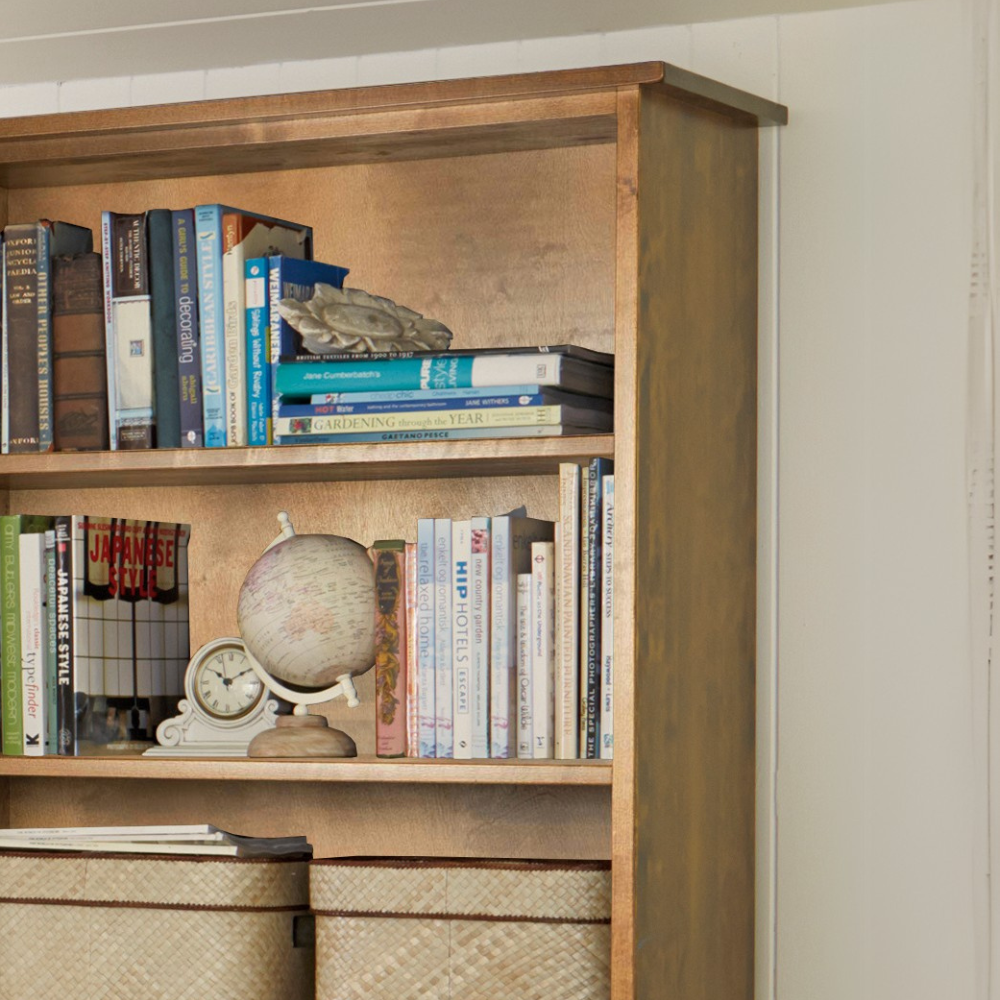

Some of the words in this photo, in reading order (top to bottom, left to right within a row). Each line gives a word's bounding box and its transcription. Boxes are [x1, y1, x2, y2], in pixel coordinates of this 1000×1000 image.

[178, 228, 187, 253] GIRL'S
[180, 257, 188, 280] GUIDE
[200, 241, 213, 288] STYLE
[37, 272, 48, 314] OTHER
[181, 284, 190, 294] TO
[179, 296, 197, 363] decorating
[270, 268, 281, 364] WEIMARANERS
[37, 319, 49, 375] PEOPLE'S
[202, 293, 217, 384] CARIBBEAN
[303, 372, 322, 380] Jane
[323, 371, 382, 379] Cumberbatch's
[421, 358, 433, 390] PURE
[434, 357, 448, 389] style
[39, 379, 50, 431] HOUSES
[188, 375, 197, 404] abigail
[229, 392, 236, 401] OF
[482, 398, 510, 406] WITHERS
[229, 403, 237, 423] BOOK
[313, 417, 395, 431] GARDENING
[397, 418, 434, 428] through
[434, 418, 448, 426] the
[448, 413, 484, 425] YEAR
[315, 405, 335, 413] HOT
[229, 425, 238, 443] RSPB
[381, 432, 423, 440] GAETANO
[423, 431, 449, 439] PESCE
[605, 502, 614, 548] Archery
[90, 534, 174, 567] JAPANESE
[438, 537, 448, 566] enkelt
[494, 534, 505, 564] enkelt
[563, 515, 573, 608] SCANDINAVIAN
[108, 566, 159, 598] STYLE
[437, 569, 446, 582] og
[456, 561, 468, 599] HIP
[475, 559, 483, 576] new
[493, 567, 504, 580] og
[419, 559, 432, 612] relaxed
[474, 579, 484, 611] country
[57, 569, 69, 639] JAPANESE
[438, 585, 448, 632] romantisk
[495, 583, 505, 631] romantisk
[419, 616, 432, 658] home
[456, 603, 469, 662] HOTELS
[474, 614, 485, 643] garden
[563, 611, 573, 662] PAINTED
[58, 644, 70, 685] STYLE
[22, 652, 39, 718] typefinder
[459, 671, 467, 711] ESCAPE
[520, 678, 529, 703] Oscar
[563, 665, 573, 736] FURNITURE
[520, 705, 532, 731] Wilde
[588, 689, 596, 733] SPECIAL
[26, 733, 40, 746] K
